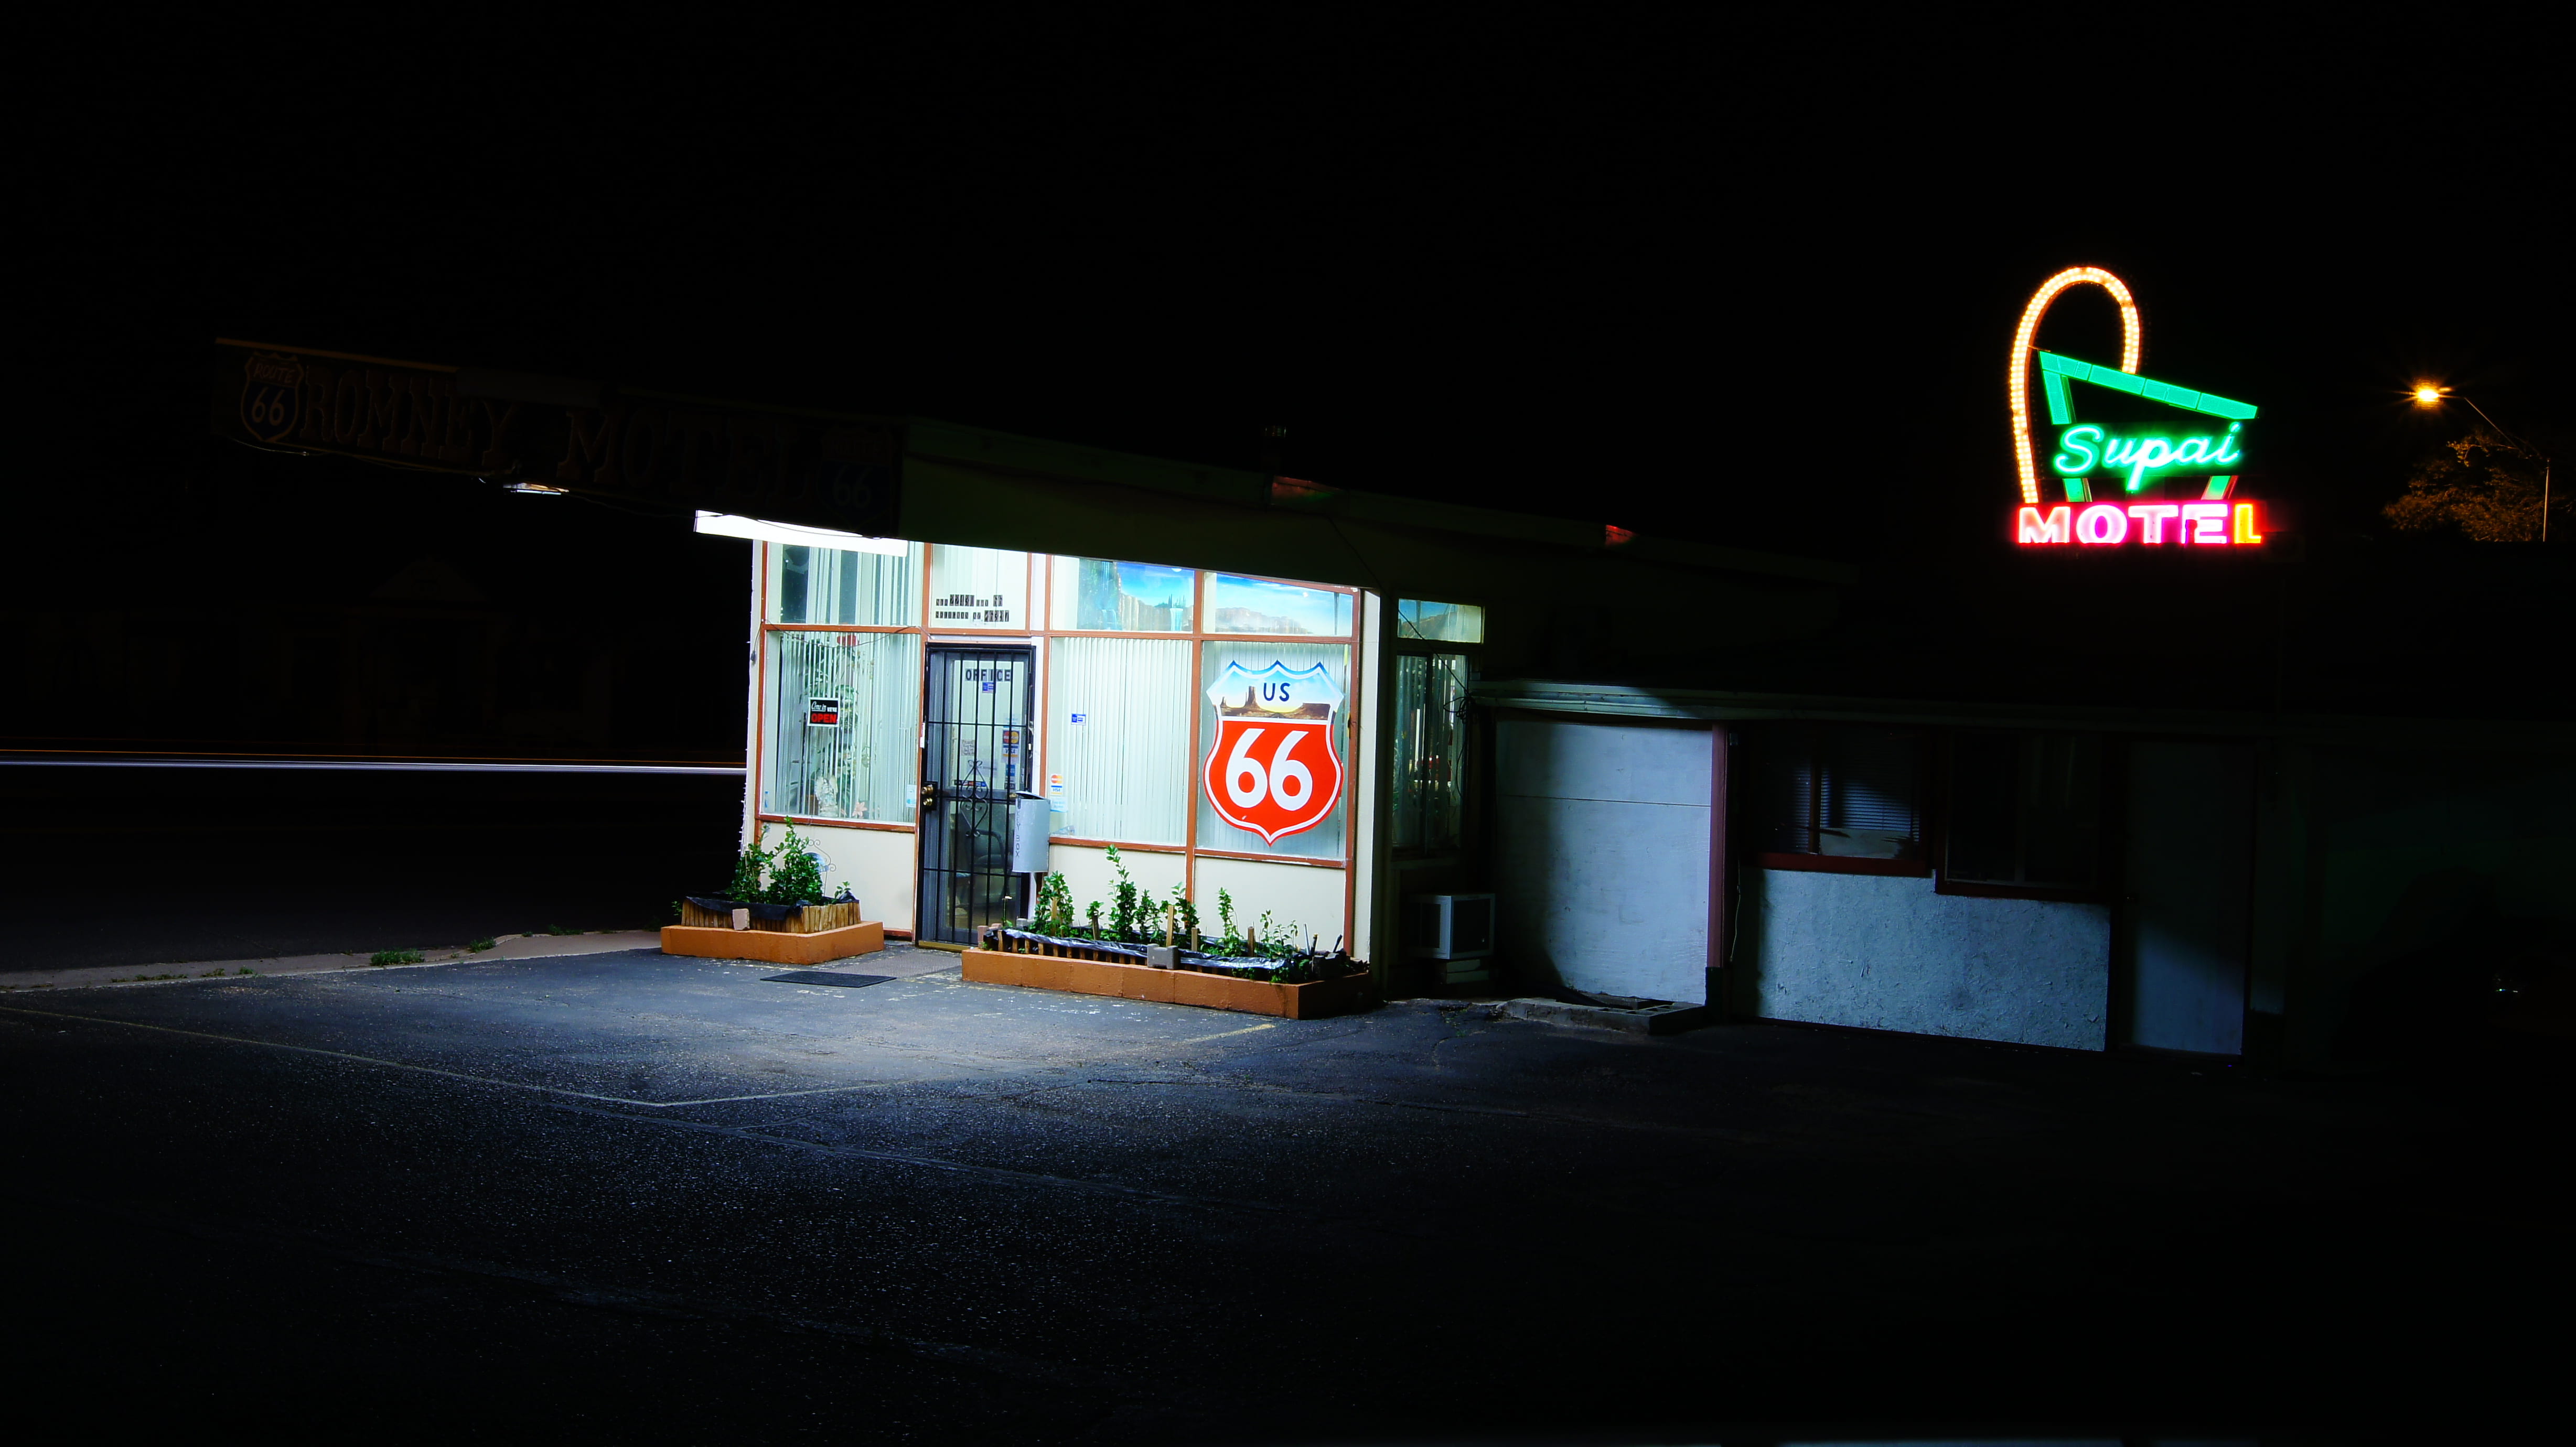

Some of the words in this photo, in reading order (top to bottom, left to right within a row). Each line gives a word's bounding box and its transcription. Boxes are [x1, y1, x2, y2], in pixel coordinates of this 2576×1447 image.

[253, 362, 296, 384] ROUTE
[251, 387, 286, 426] 66
[299, 365, 518, 466] ROMNEY
[556, 403, 814, 510] MOTEL
[2054, 422, 2241, 491] Supai
[832, 465, 873, 507] 66
[2018, 503, 2262, 544] MOTEL
[965, 668, 1012, 682] OFFICE
[1263, 683, 1291, 701] US
[811, 713, 837, 723] OPEN
[1226, 728, 1313, 811] 66
